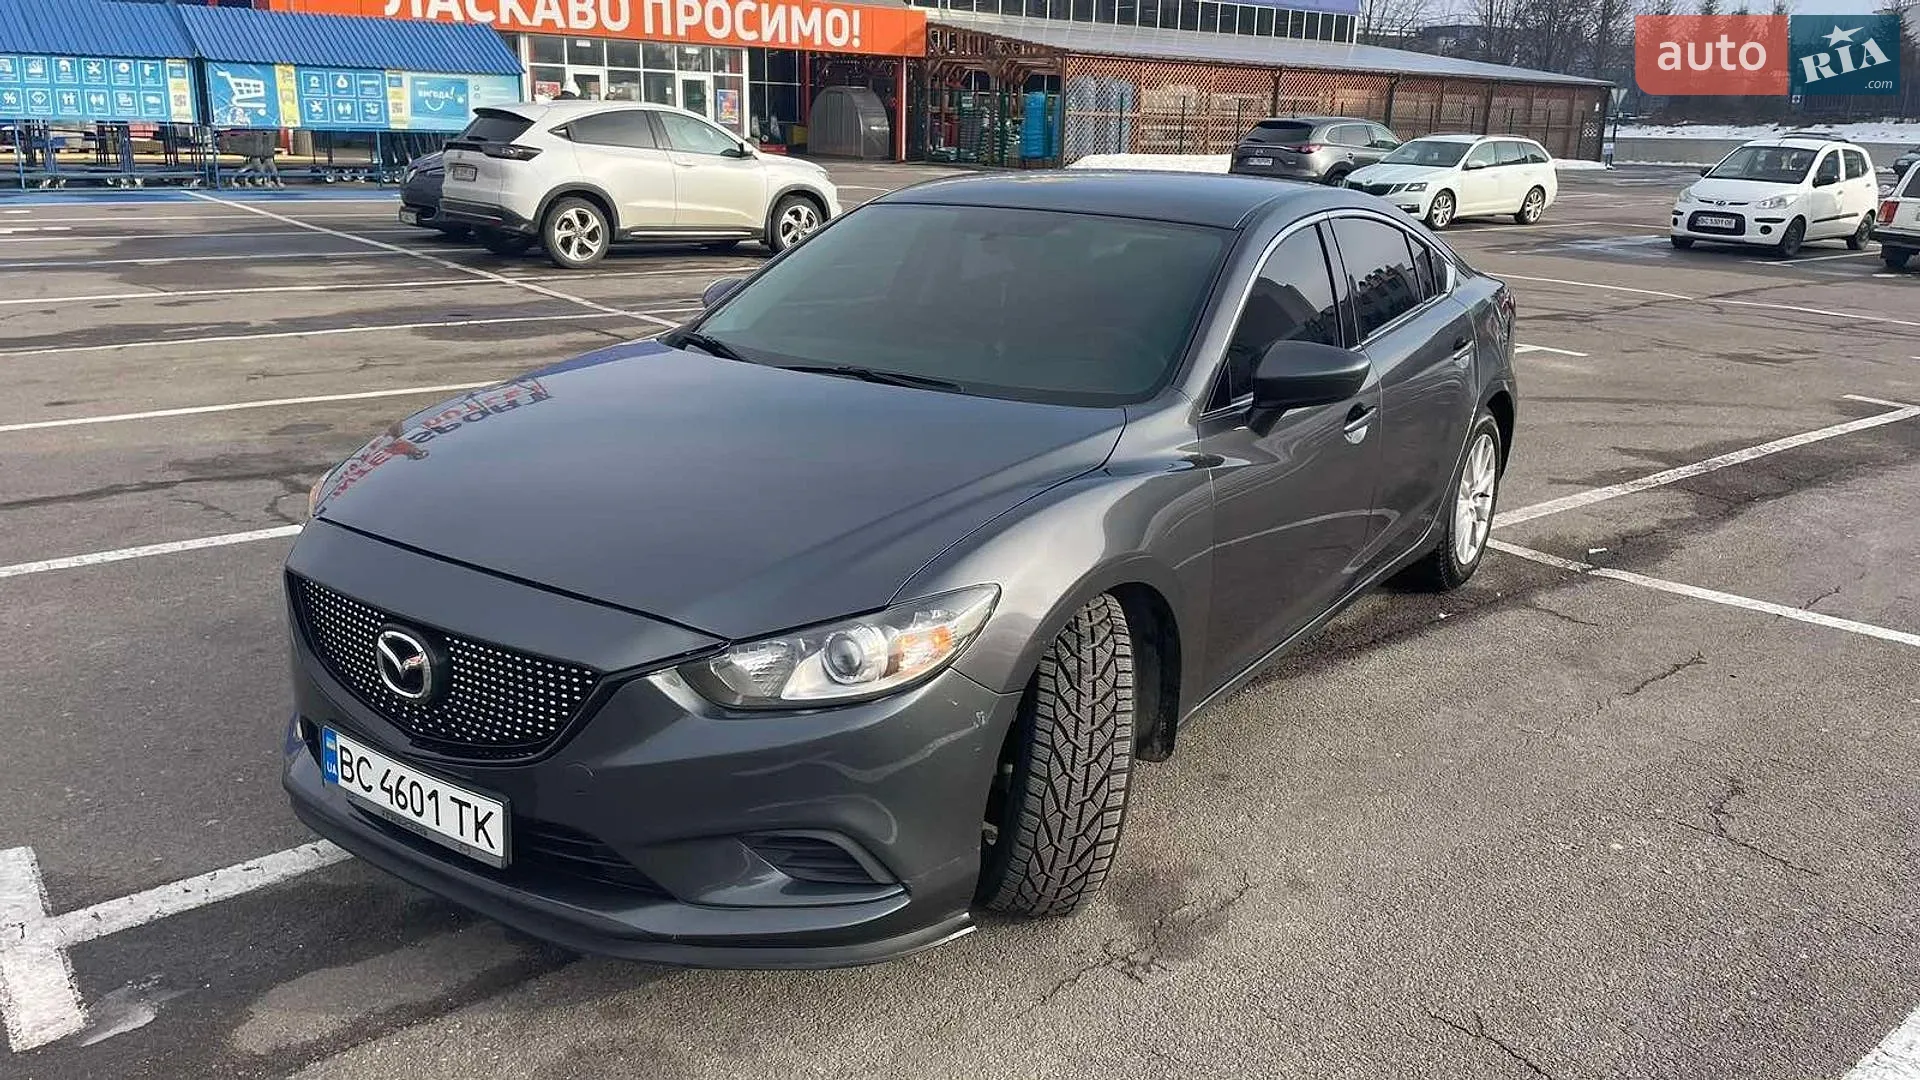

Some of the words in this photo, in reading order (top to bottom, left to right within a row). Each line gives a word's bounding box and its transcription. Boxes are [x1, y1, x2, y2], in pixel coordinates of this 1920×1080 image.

[643, 0, 861, 48] ПРОСИМО!
[326, 761, 338, 776] UA
[339, 744, 373, 792] BC
[380, 768, 440, 826] 4601
[450, 796, 495, 849] TK
